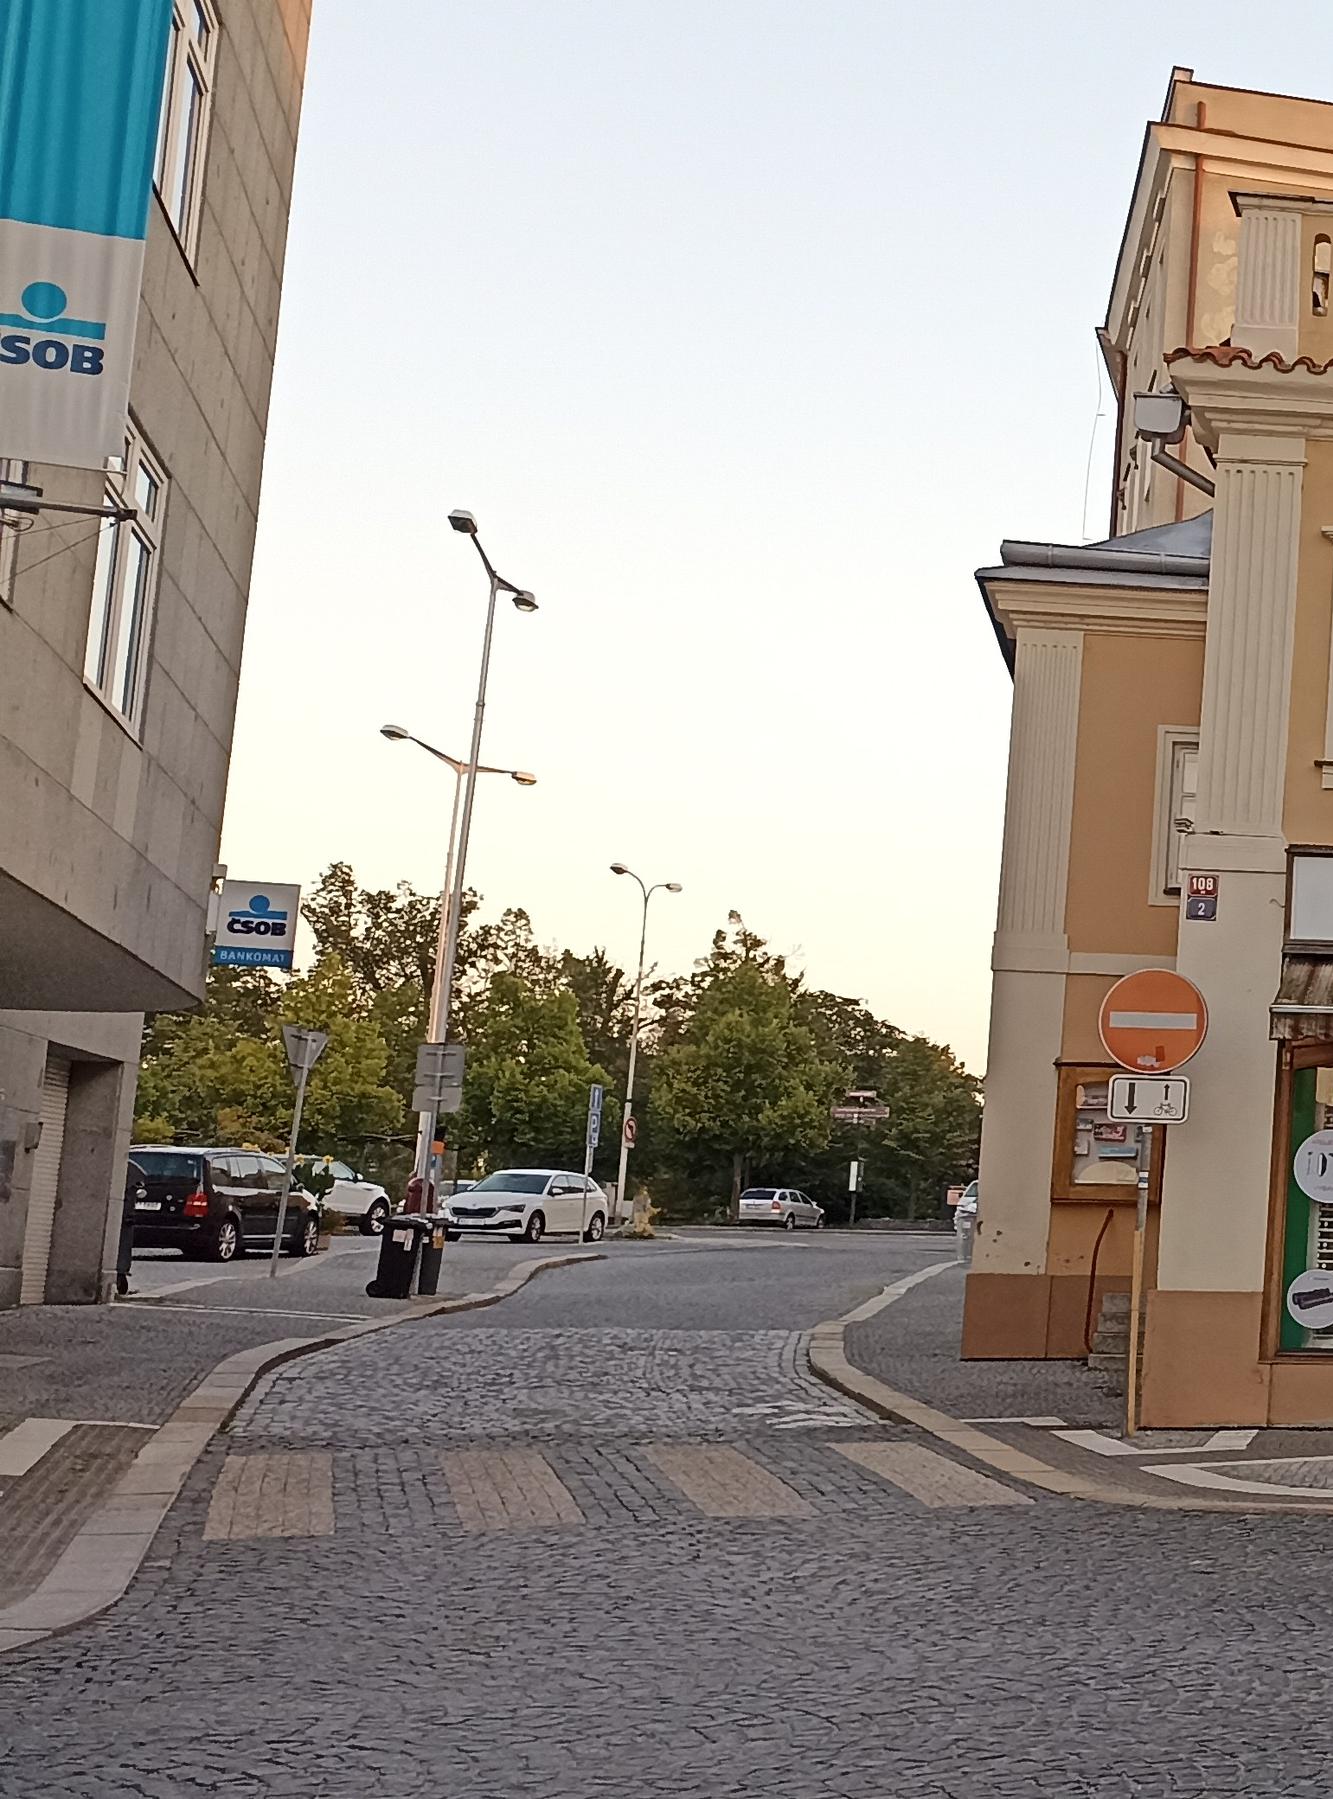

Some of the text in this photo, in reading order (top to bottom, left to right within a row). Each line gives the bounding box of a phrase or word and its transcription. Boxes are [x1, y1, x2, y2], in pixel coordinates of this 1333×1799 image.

[0, 334, 105, 376] SOB
[1192, 877, 1214, 891] 108
[1197, 902, 1206, 916] 2
[226, 918, 287, 937] ČSOB
[220, 950, 285, 962] BANKOMAT
